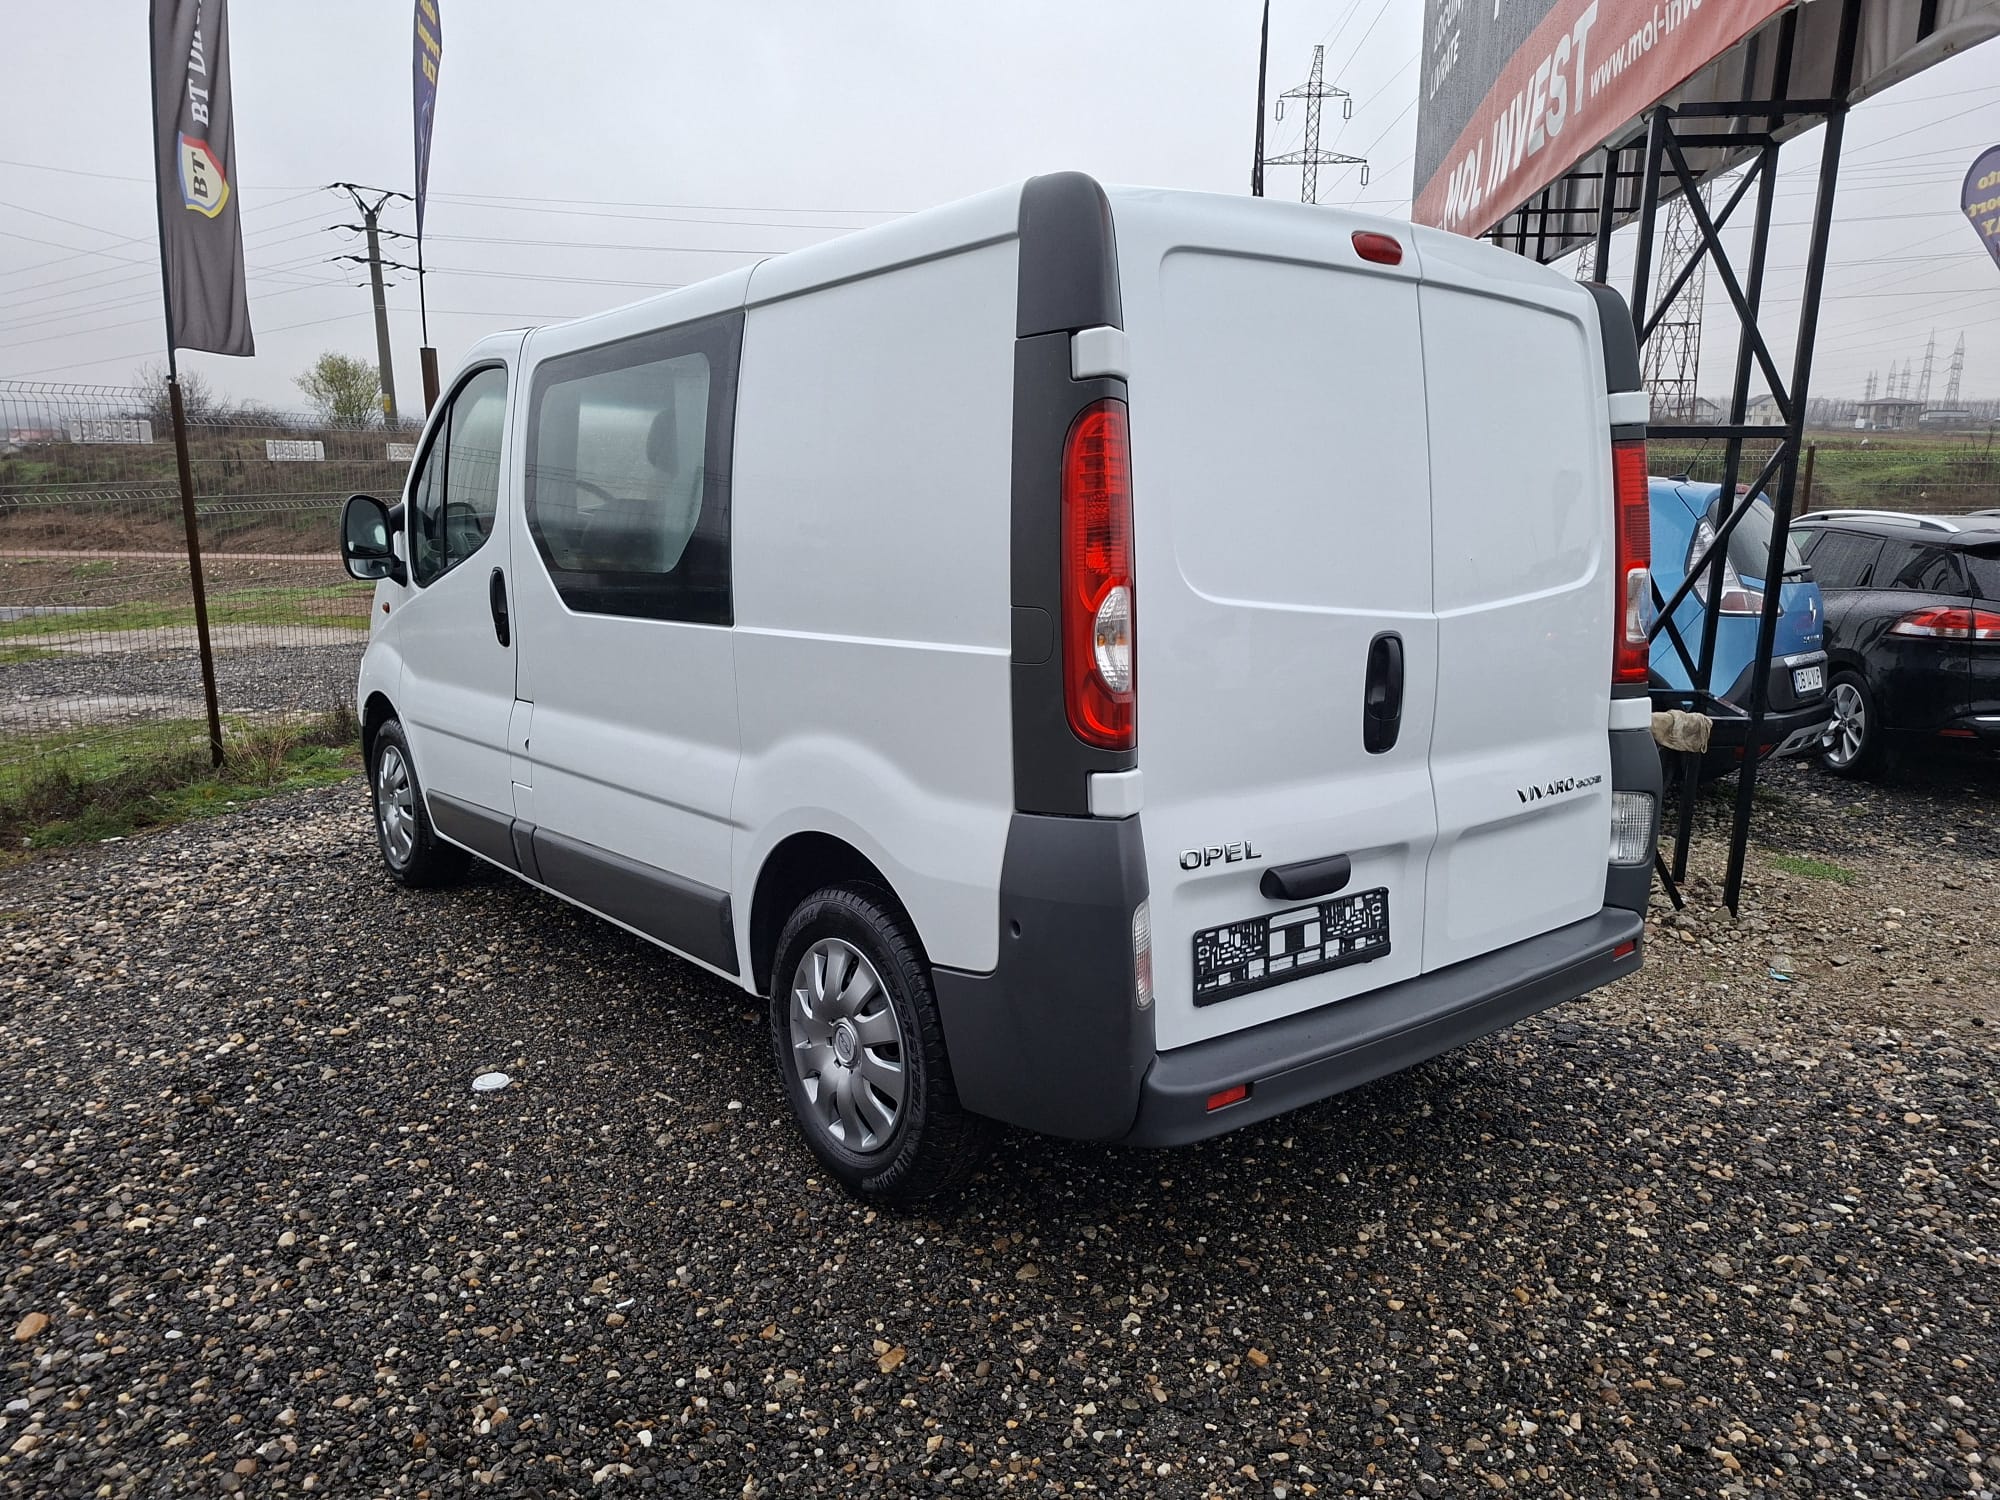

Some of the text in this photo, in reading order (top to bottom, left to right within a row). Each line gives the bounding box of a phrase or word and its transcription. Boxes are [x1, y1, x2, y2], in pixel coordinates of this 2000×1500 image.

[1430, 28, 1460, 101] LIVRATE
[1443, 0, 1599, 231] MOL INVEST
[191, 151, 209, 199] BT
[1516, 777, 1575, 804] VIVARO
[1179, 839, 1262, 871] OPEL
